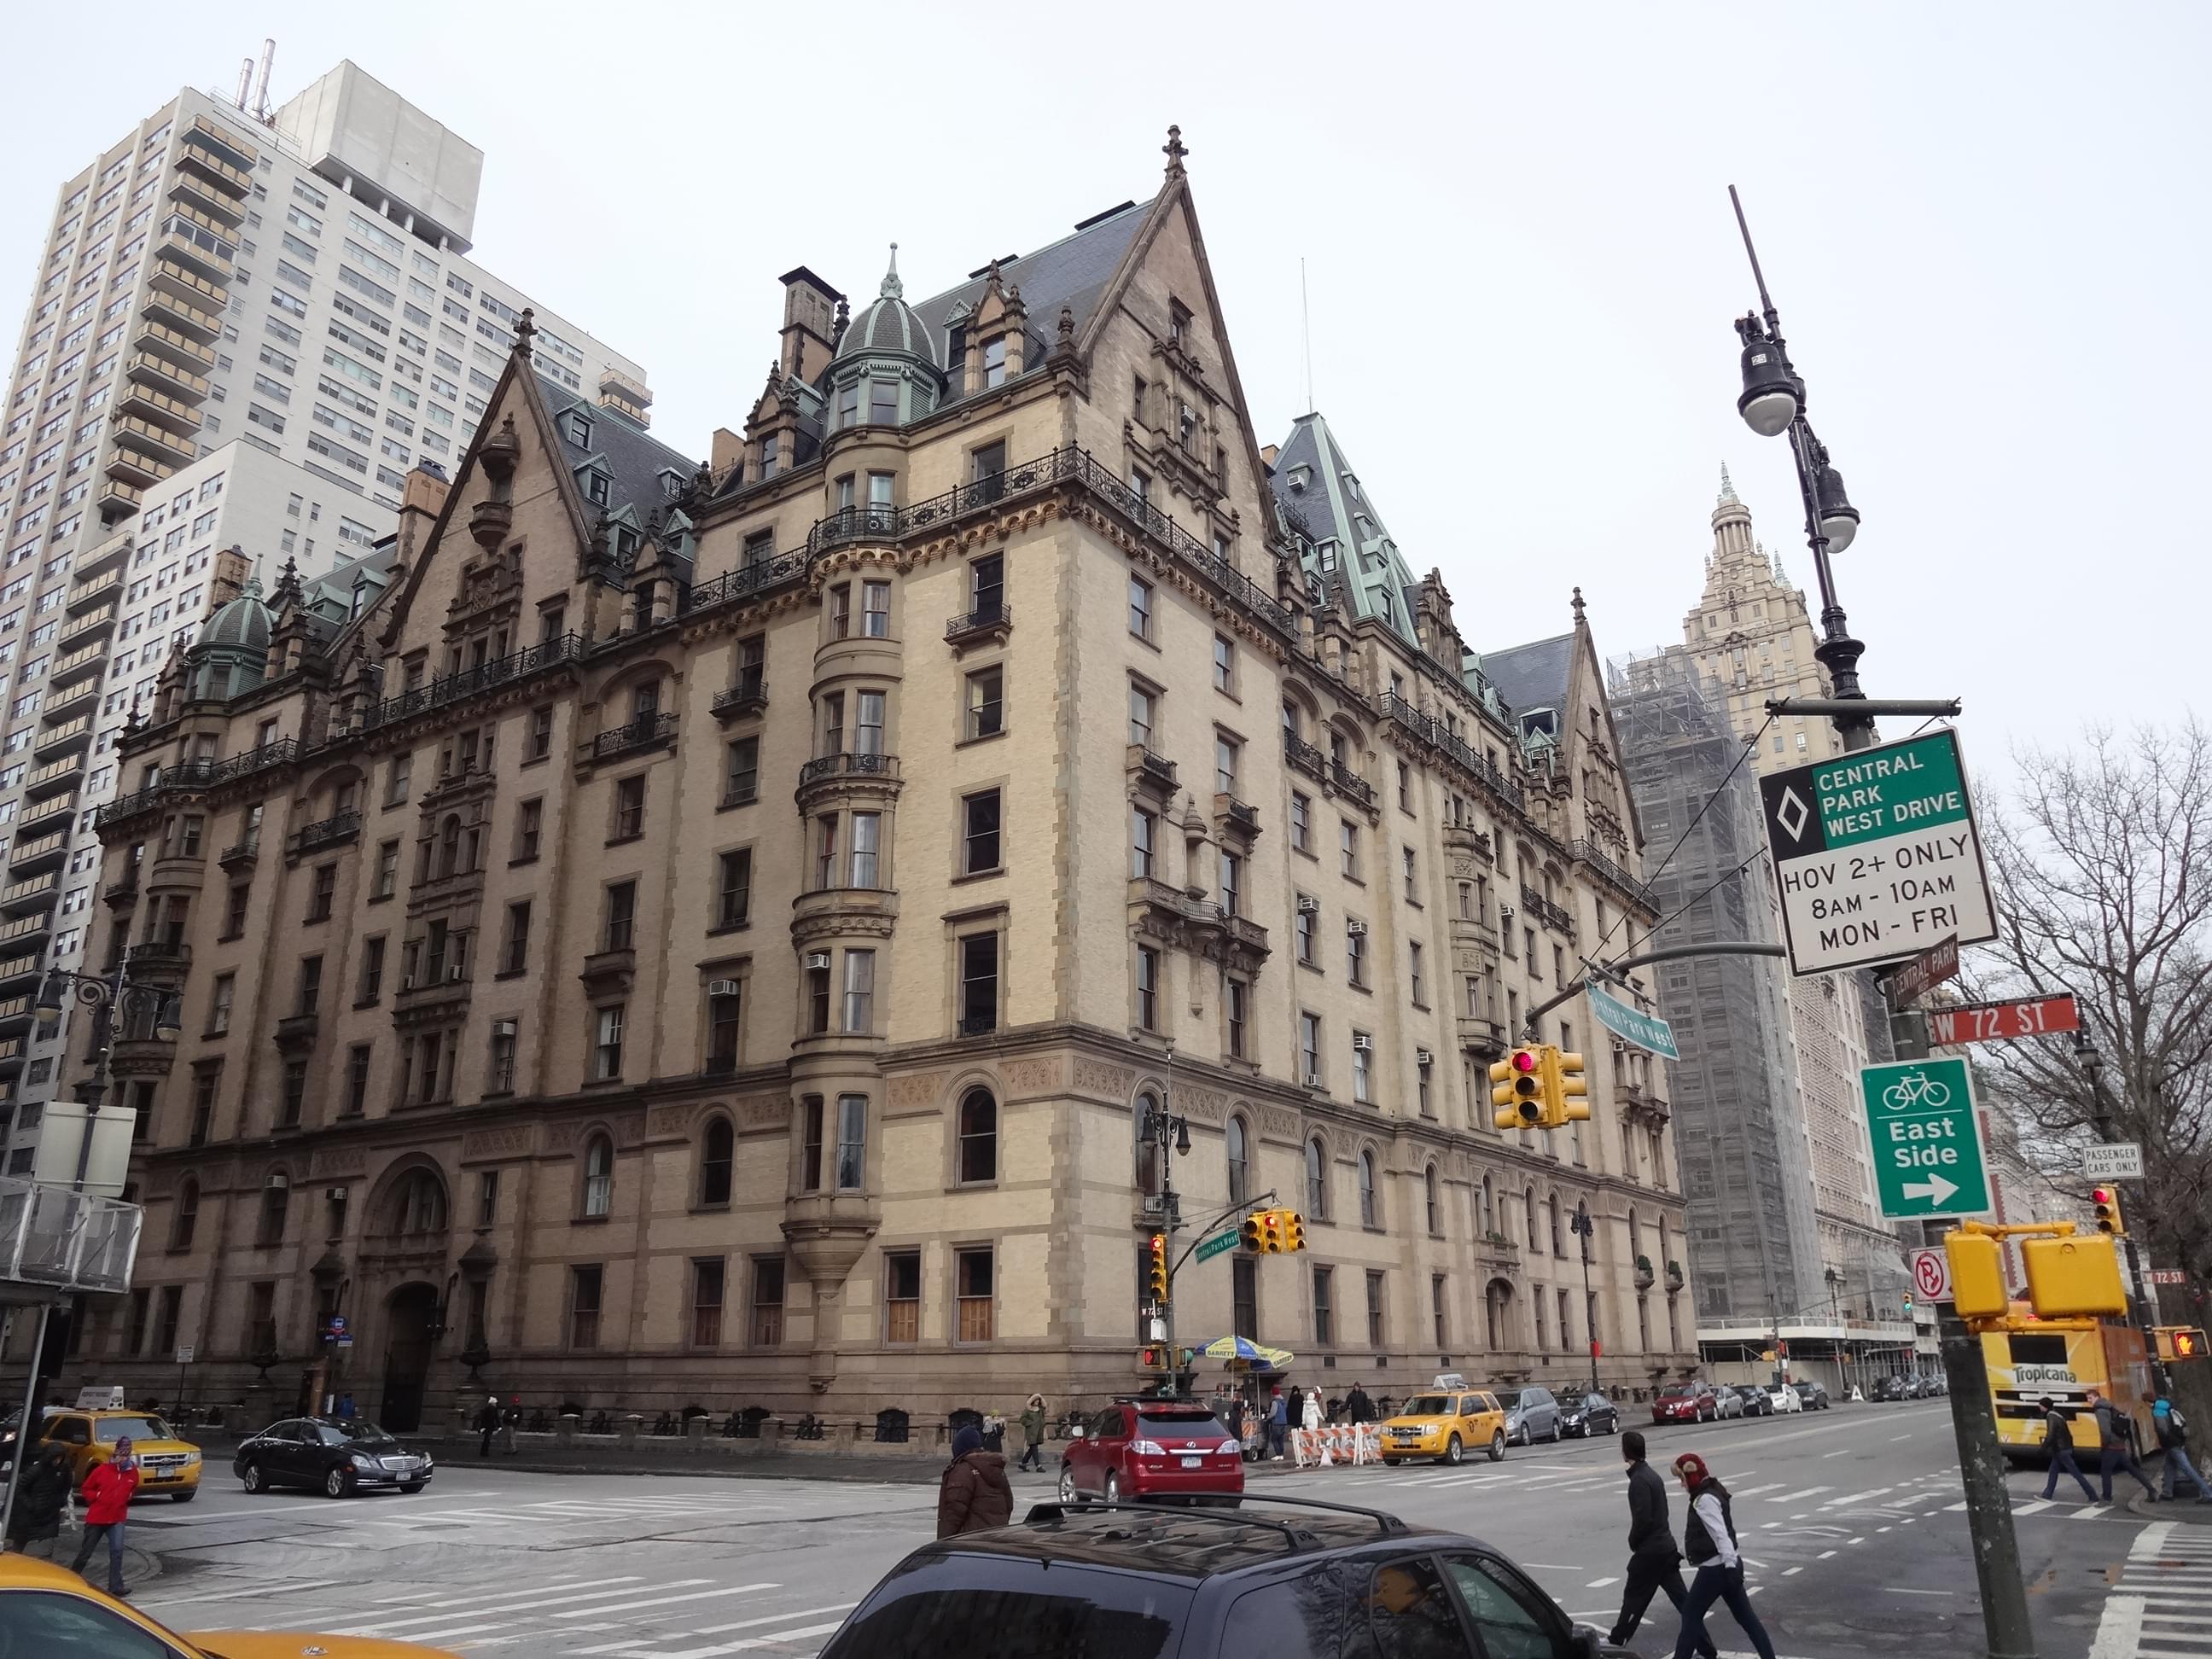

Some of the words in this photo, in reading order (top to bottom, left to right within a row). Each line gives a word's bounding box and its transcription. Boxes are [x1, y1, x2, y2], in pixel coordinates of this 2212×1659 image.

[1819, 752, 1924, 791] CENTRAL
[1822, 785, 1883, 815] PARK
[1827, 809, 1883, 837] WEST
[1893, 791, 1962, 823] DRIVE
[1784, 863, 1836, 894] HOV
[1848, 855, 1886, 880] 2+
[1895, 833, 1968, 869] ONLY
[1811, 894, 1862, 920] 8AM
[1889, 875, 1956, 904] 10AM
[1819, 920, 1880, 951] MON
[1912, 904, 1959, 933] FRI
[1895, 959, 1930, 996] CENTRAL
[1931, 941, 1957, 973] PARK
[1621, 1012, 1646, 1039] Park
[1644, 1023, 1674, 1049] West
[1935, 1013, 1955, 1042] W
[1969, 1008, 2002, 1038] 72
[2016, 1003, 2045, 1033] ST
[1889, 1117, 1956, 1142] East
[1894, 1144, 1959, 1167] Side
[2086, 1149, 2136, 1161] PASSENGER
[2087, 1162, 2110, 1173] CARS
[2116, 1161, 2137, 1172] ONLY
[1224, 1233, 1237, 1246] West
[2156, 1272, 2168, 1284] 72
[2170, 1272, 2182, 1284] ST
[1156, 1307, 1163, 1315] ST
[2012, 1365, 2077, 1383] Tropicana
